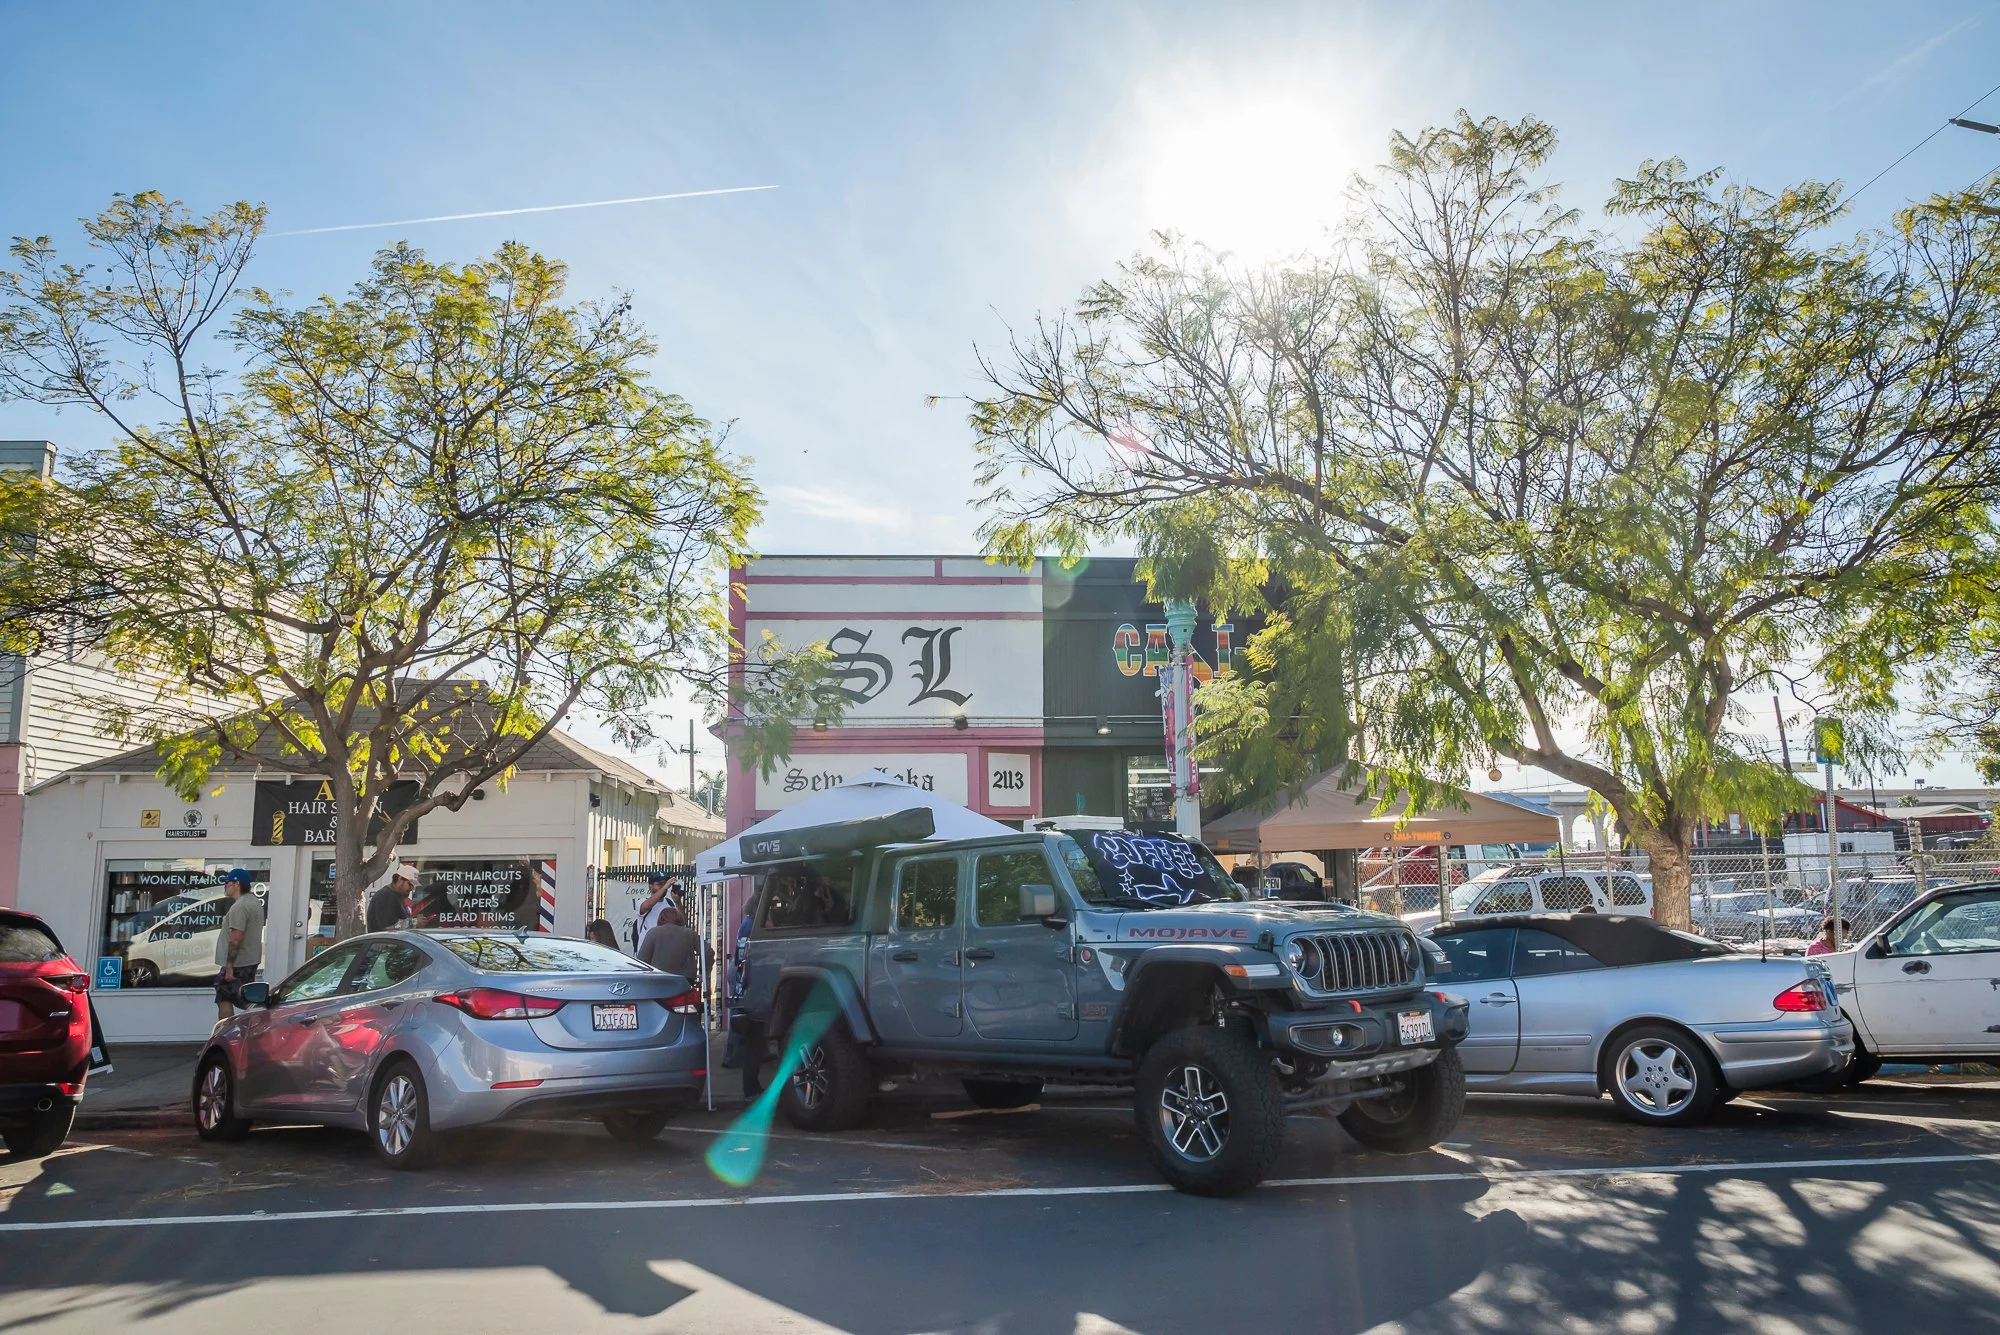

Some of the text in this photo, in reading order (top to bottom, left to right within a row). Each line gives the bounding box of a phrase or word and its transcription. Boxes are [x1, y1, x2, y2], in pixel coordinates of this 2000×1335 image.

[812, 627, 974, 707] SL
[992, 770, 1025, 790] 2113
[288, 802, 327, 814] HAIR
[140, 875, 186, 885] WOMEN
[436, 870, 522, 881] MEN HAIRCUTS
[446, 884, 511, 895] SKIN FADES
[457, 898, 499, 908] TAPERS
[153, 915, 226, 926] TREATMENT
[439, 911, 515, 923] BEARD TRIMS
[1128, 927, 1249, 941] MOJAVE
